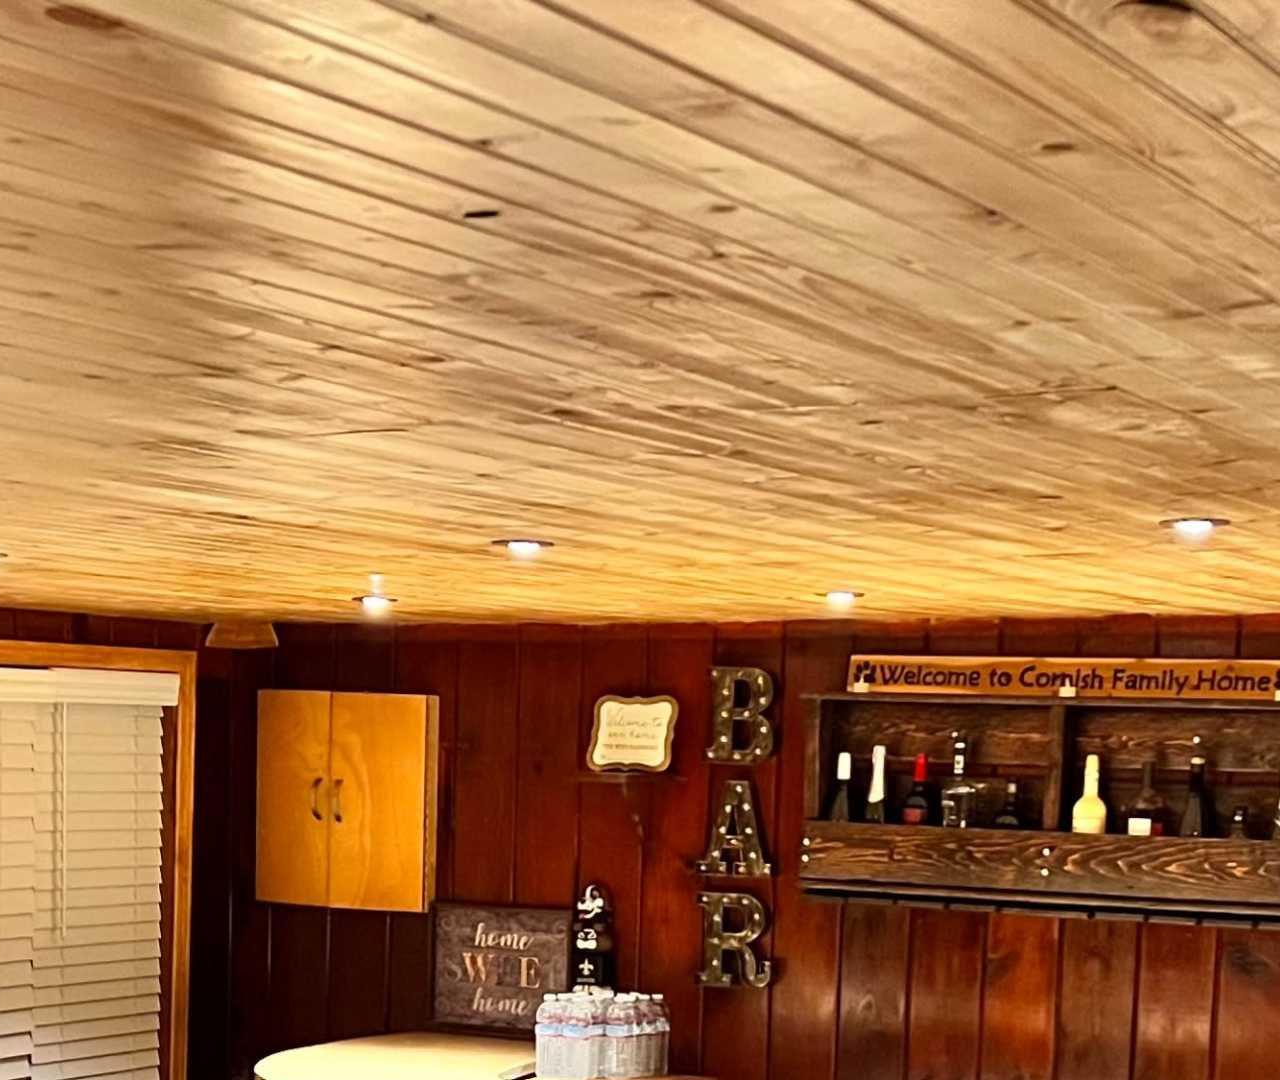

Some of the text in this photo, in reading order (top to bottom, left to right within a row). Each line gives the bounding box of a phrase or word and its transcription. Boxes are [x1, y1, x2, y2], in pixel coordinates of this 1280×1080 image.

[879, 663, 1271, 695] Welcome to Cornish Family Home
[696, 666, 773, 988] BAR
[474, 922, 535, 950] home
[473, 986, 532, 1015] home
